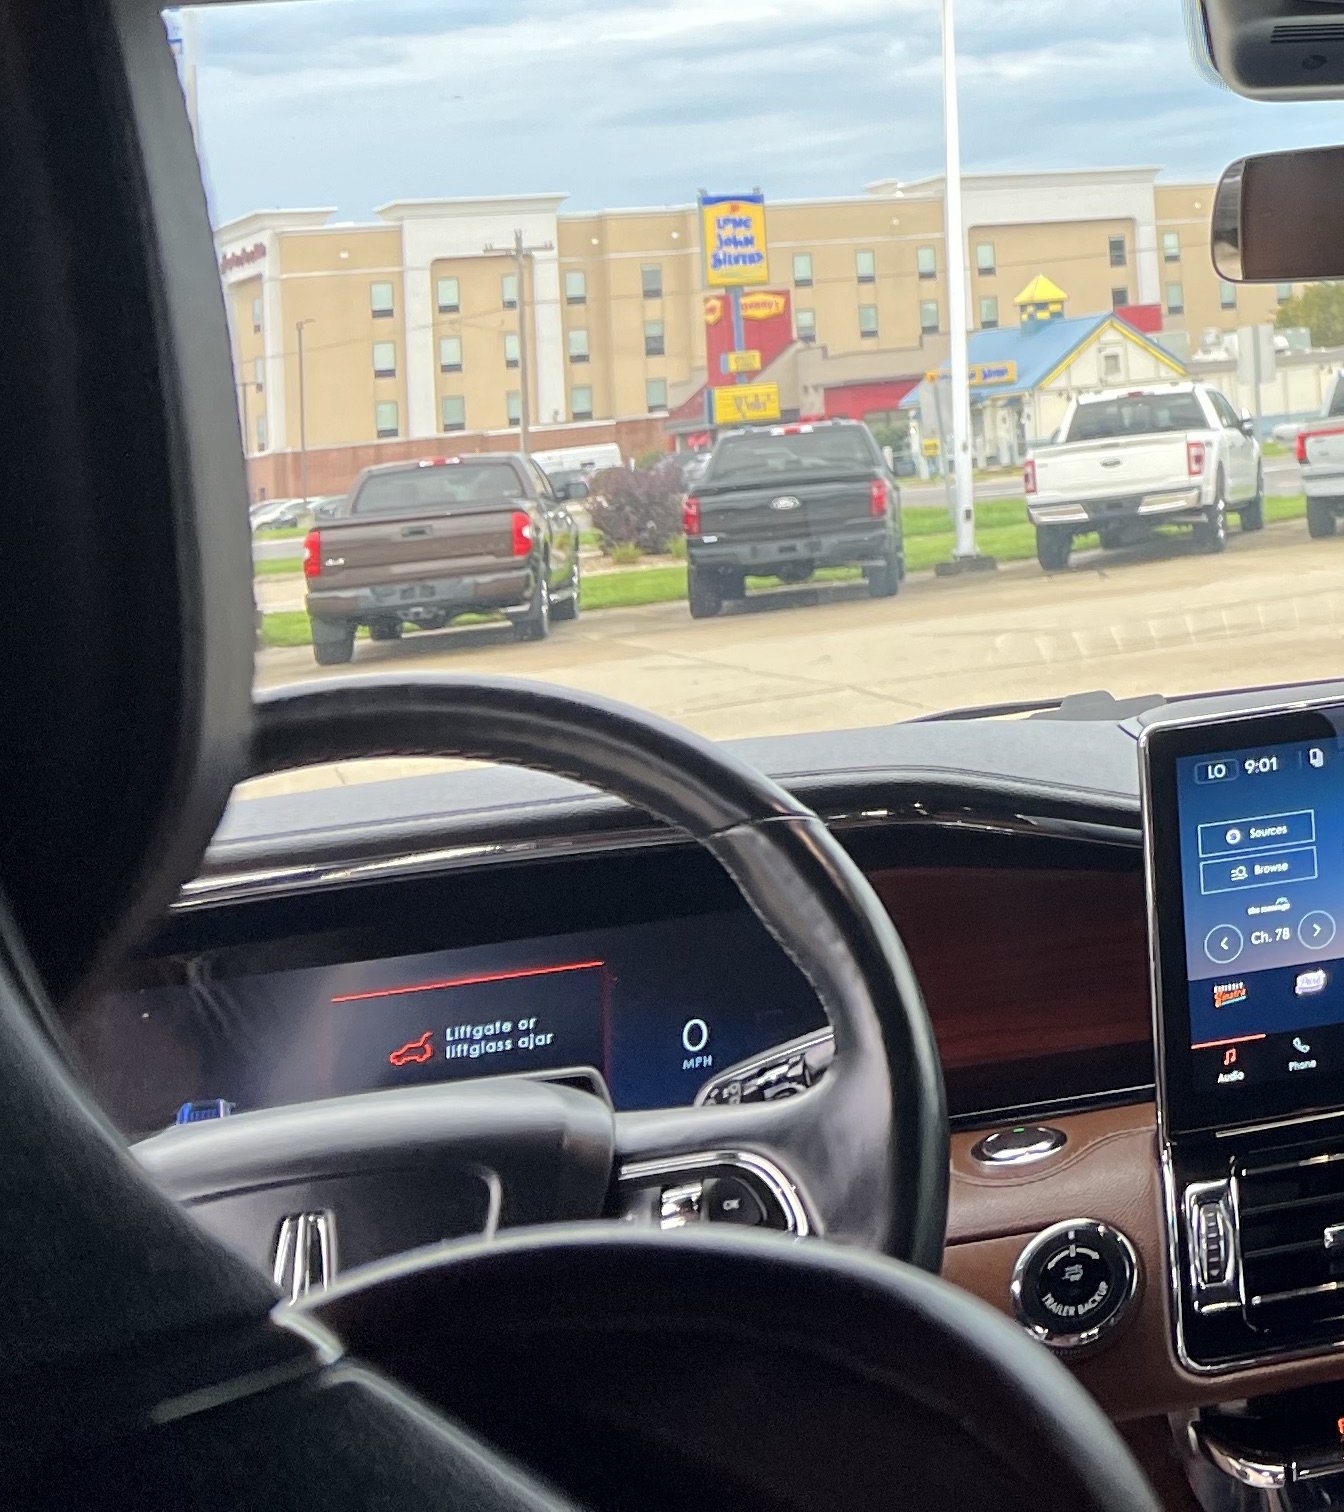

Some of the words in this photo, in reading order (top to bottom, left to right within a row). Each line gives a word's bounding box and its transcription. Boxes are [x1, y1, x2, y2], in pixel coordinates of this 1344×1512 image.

[1207, 763, 1226, 779] LO
[1244, 756, 1278, 774] 9:01
[1249, 825, 1288, 839] Sources
[1254, 862, 1289, 875] Browse
[1250, 930, 1273, 945] Ch.
[1275, 927, 1291, 941] 78
[445, 1020, 512, 1041] Liftgate
[518, 1017, 538, 1031] or
[682, 1018, 709, 1052] 0
[445, 1039, 513, 1060] liftglass
[518, 1032, 554, 1051] ajar
[681, 1054, 713, 1071] MPH
[1288, 1059, 1317, 1072] Phone
[1217, 1070, 1245, 1084] Audio
[1041, 1292, 1076, 1316] TRAILER
[1077, 1280, 1109, 1315] BACKUP
